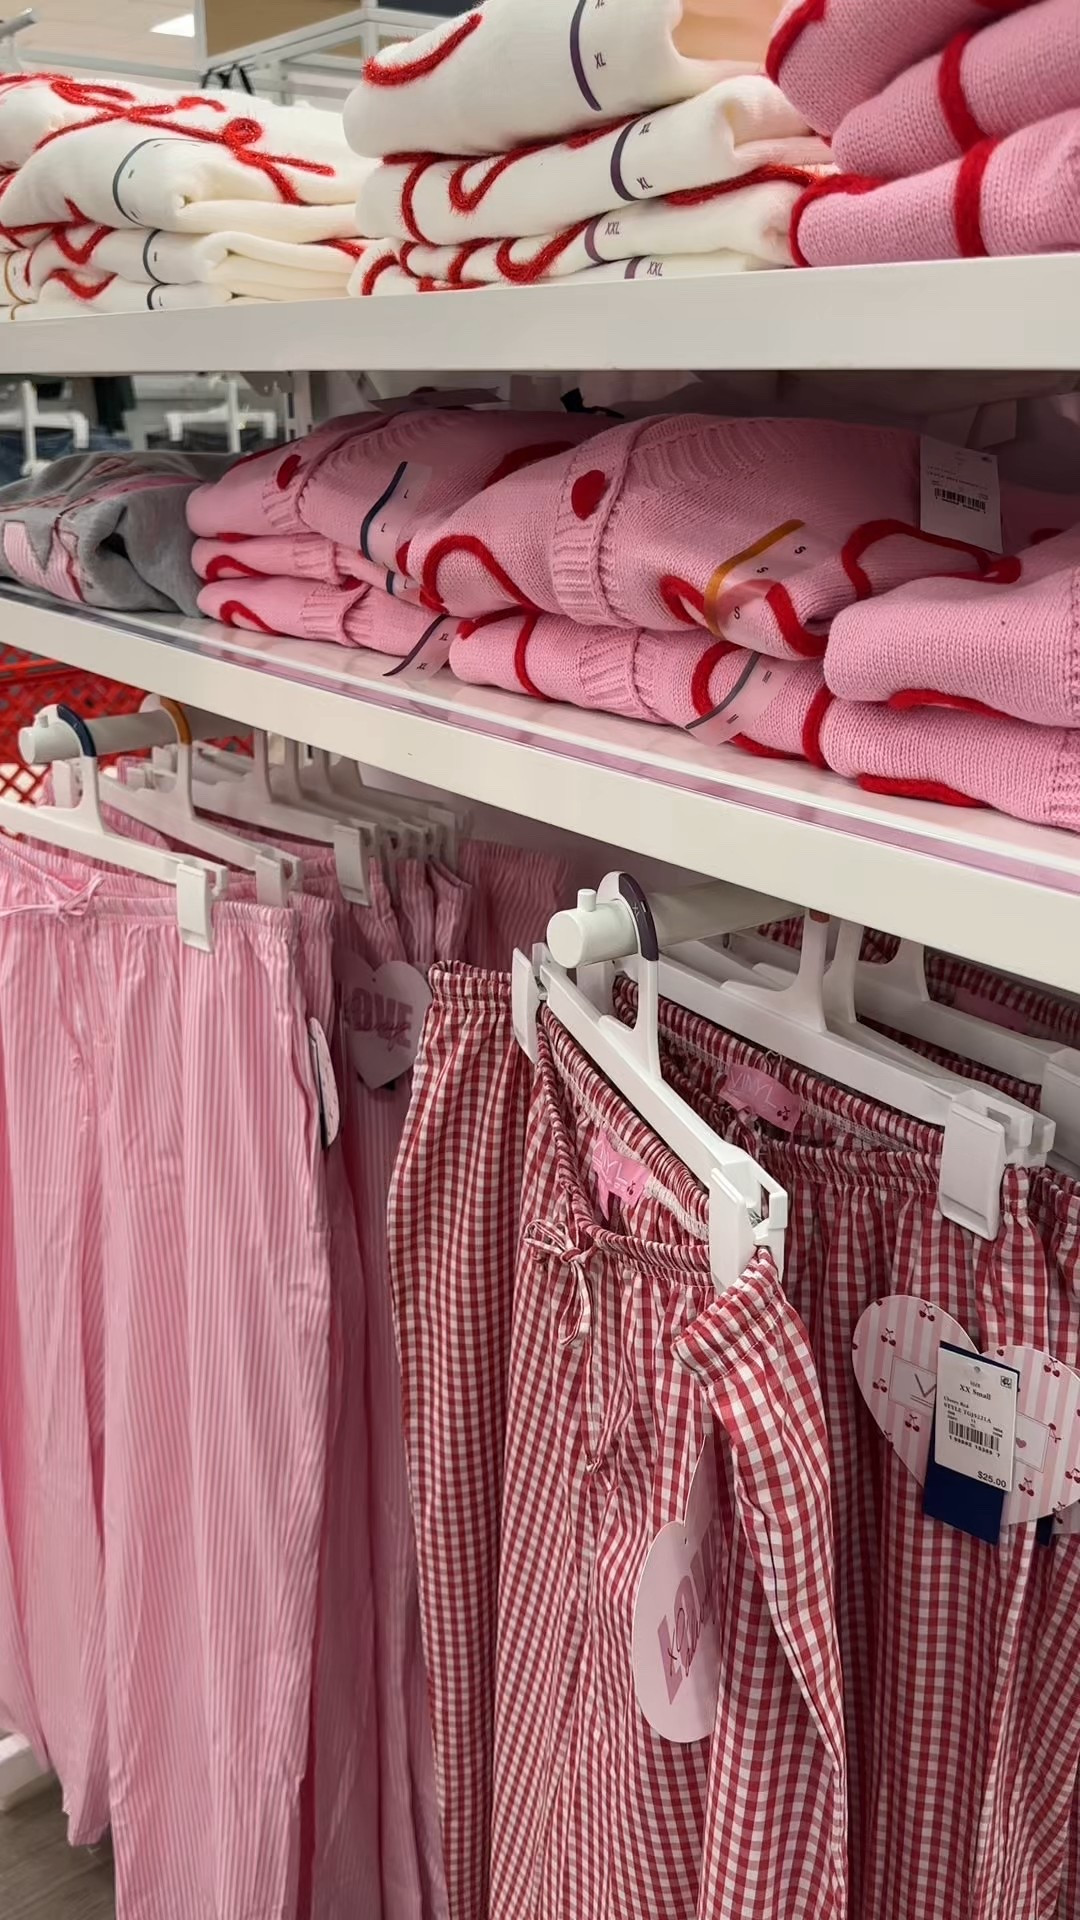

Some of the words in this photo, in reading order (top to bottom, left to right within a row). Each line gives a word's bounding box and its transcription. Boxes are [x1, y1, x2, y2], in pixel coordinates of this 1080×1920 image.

[594, 52, 606, 69] XL
[639, 122, 651, 136] XL
[636, 177, 653, 190] XL
[605, 222, 620, 235] XXL
[647, 261, 663, 277] XXL
[403, 489, 409, 499] L
[381, 523, 386, 533] L
[794, 546, 807, 554] S
[403, 579, 408, 589] L
[734, 606, 740, 620] S
[350, 988, 413, 1048] OVE
[730, 1069, 777, 1109] VINYL
[960, 1384, 970, 1393] XX
[973, 1389, 991, 1400] Small
[977, 1471, 1007, 1488] $25.00
